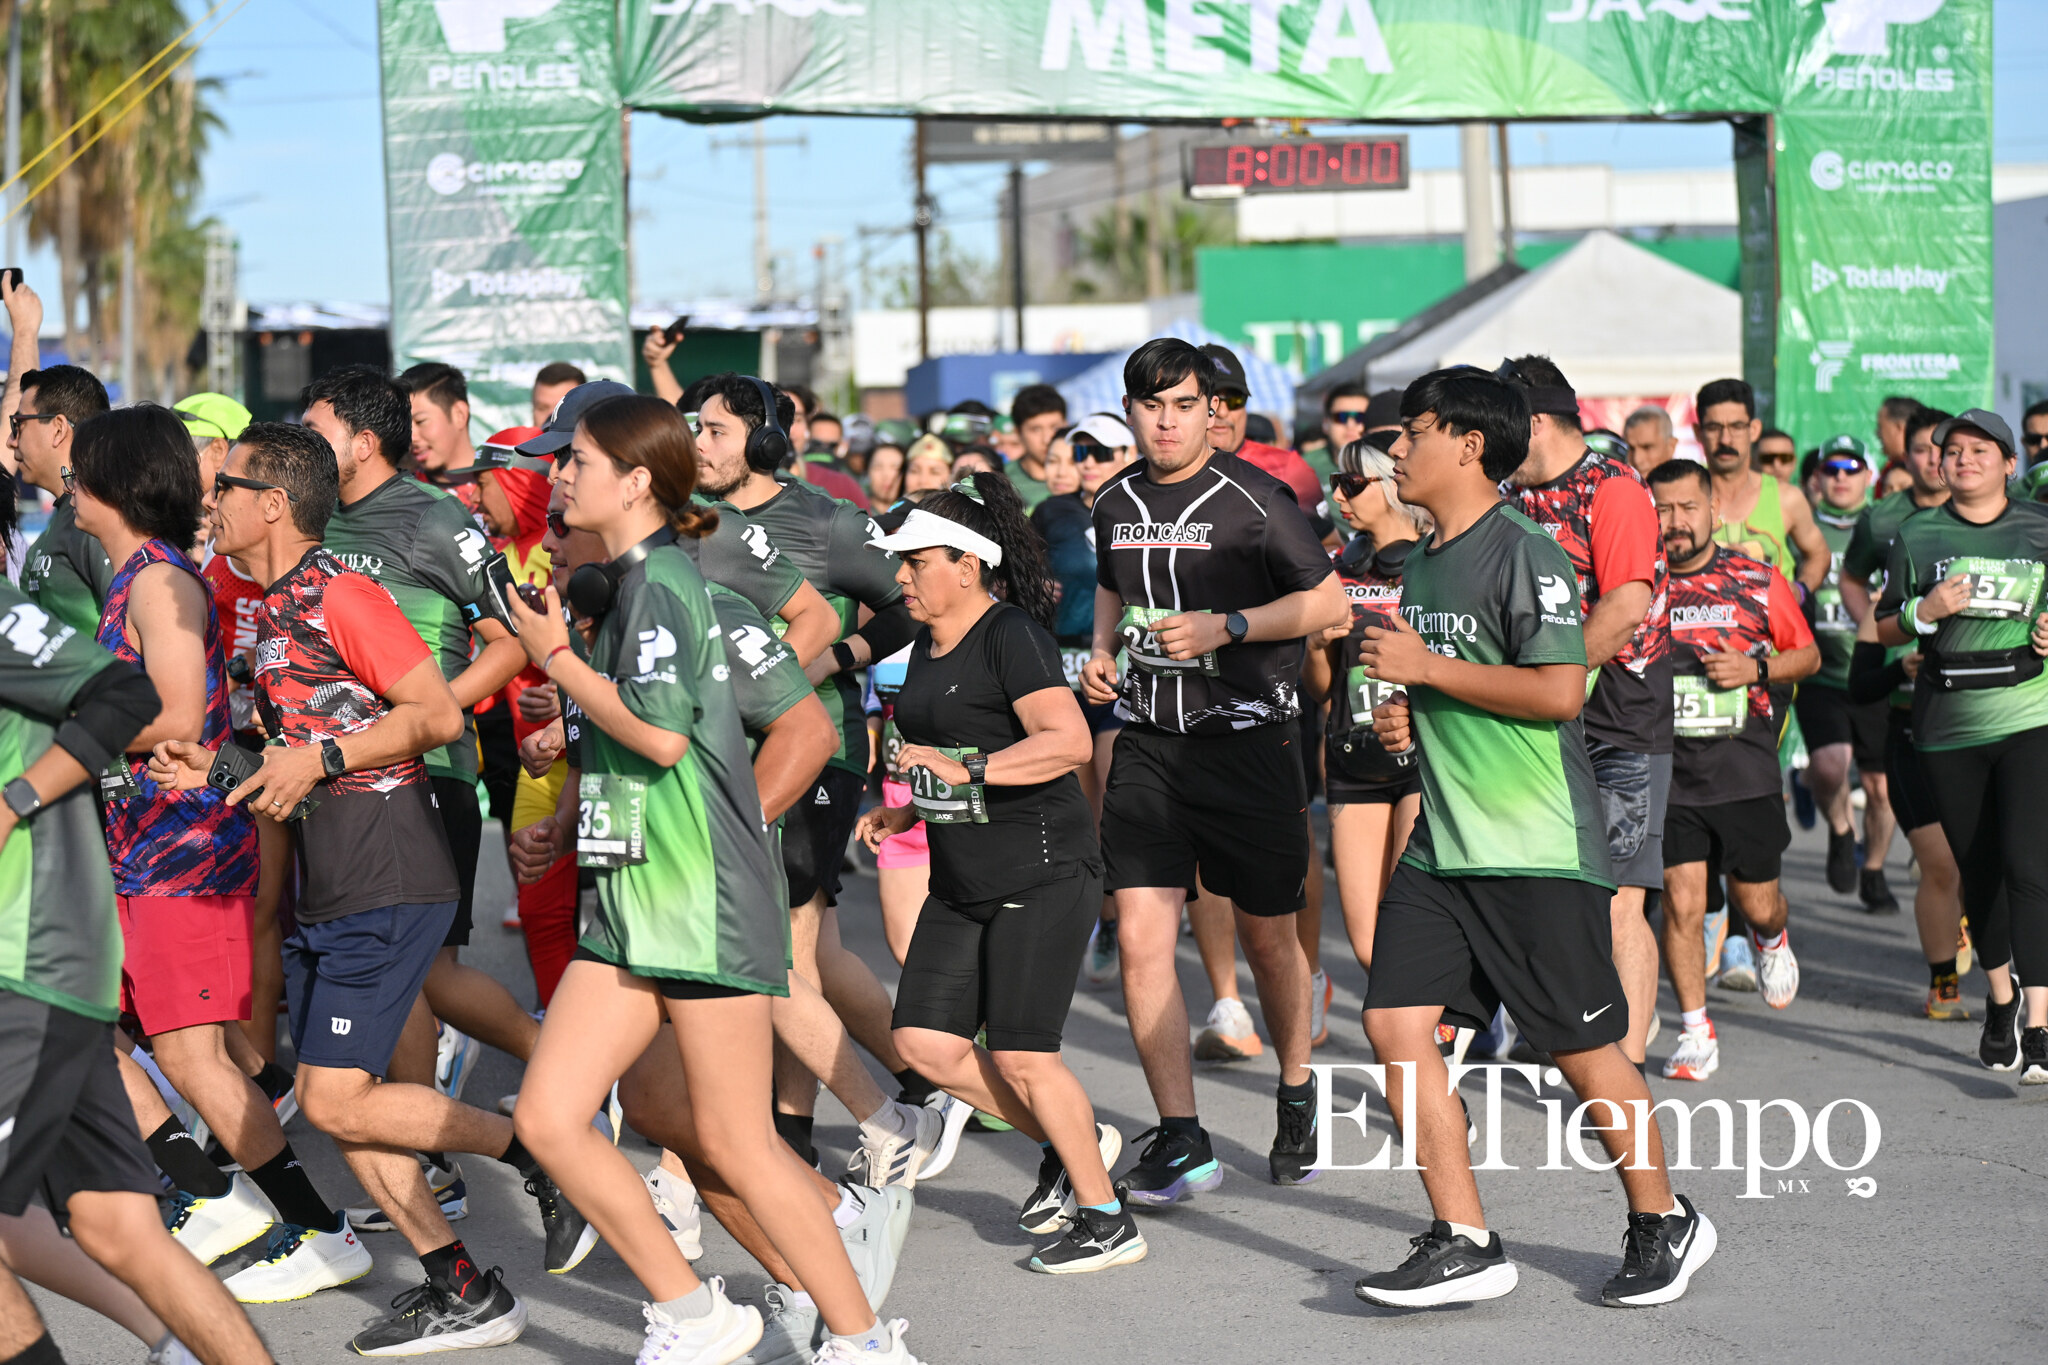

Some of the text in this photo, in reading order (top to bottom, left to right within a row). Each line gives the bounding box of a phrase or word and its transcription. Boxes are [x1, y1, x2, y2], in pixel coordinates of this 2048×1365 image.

[1040, 0, 1393, 74] META
[1840, 264, 1949, 294] Totalplay
[1861, 353, 1961, 372] FRONTERA
[1112, 522, 1214, 543] IRONCAST
[577, 799, 612, 839] 35
[630, 797, 642, 859] MEDALLA
